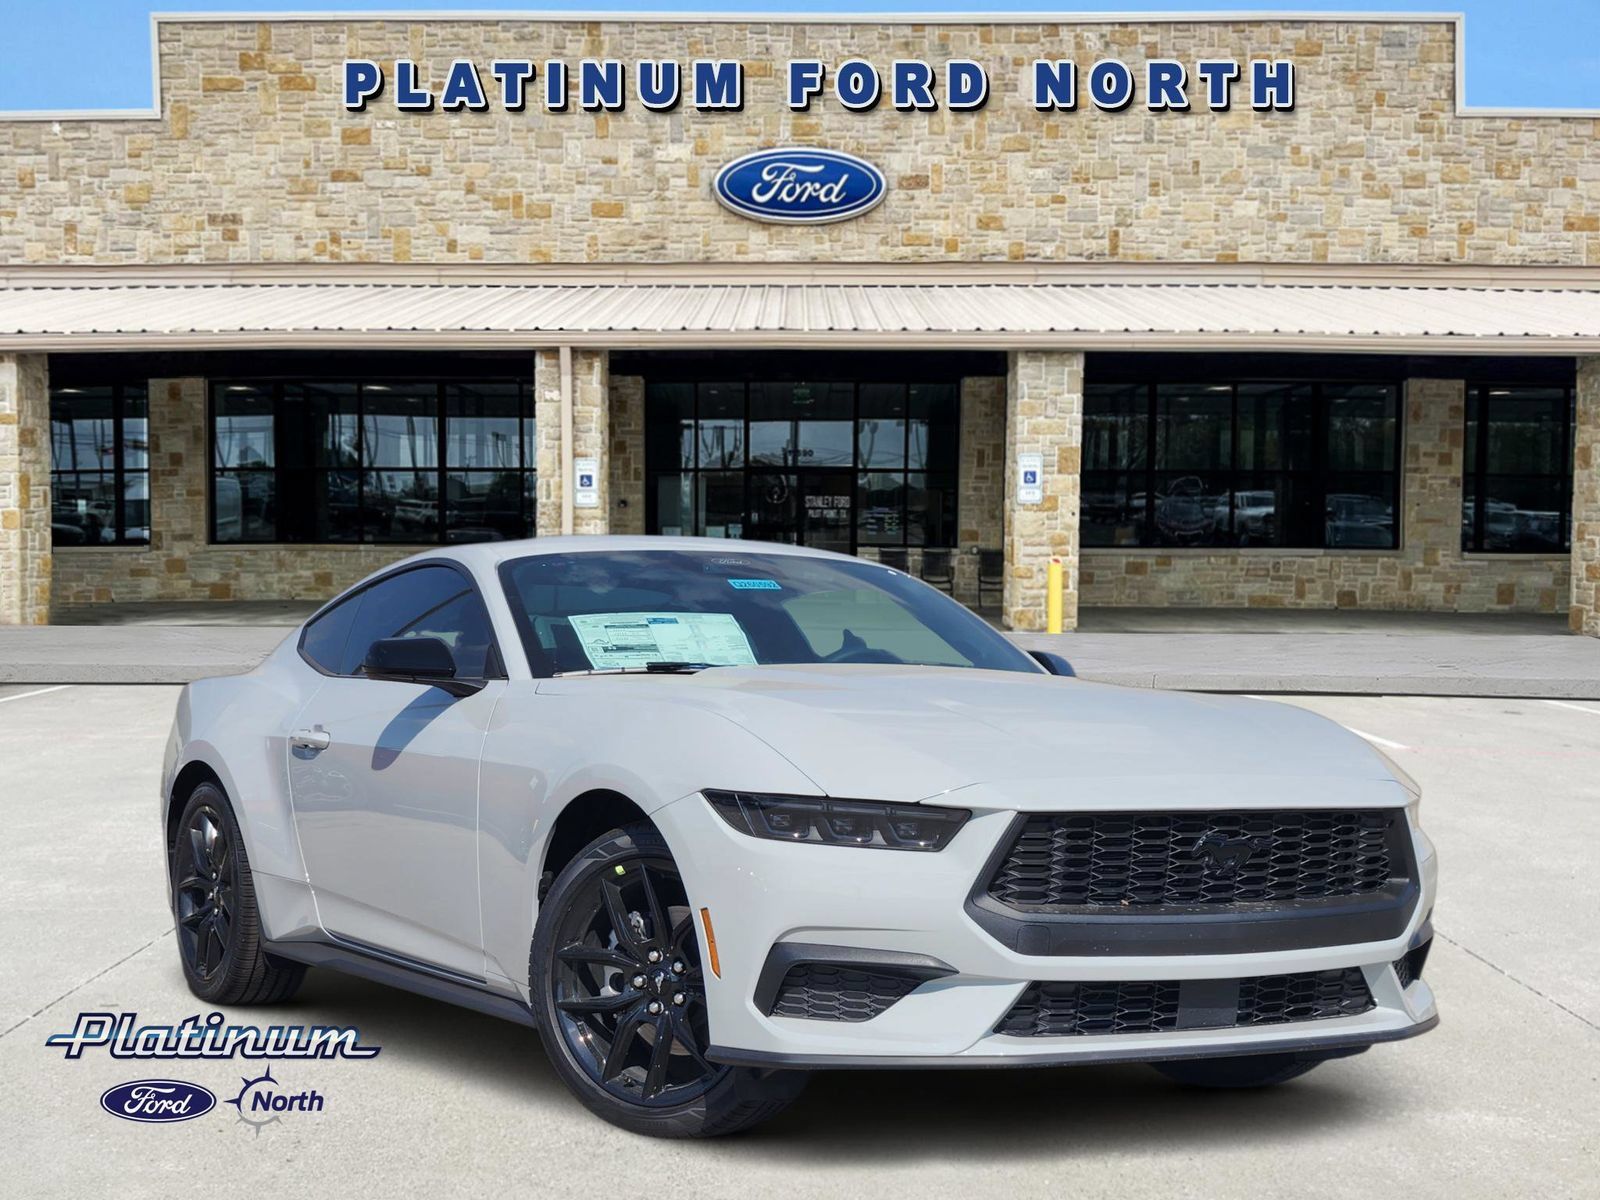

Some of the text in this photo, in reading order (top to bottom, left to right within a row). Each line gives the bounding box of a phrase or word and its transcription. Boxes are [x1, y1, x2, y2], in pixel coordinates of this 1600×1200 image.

[343, 58, 1295, 112] PLATINUM FORD NORTH
[751, 162, 848, 204] Ford
